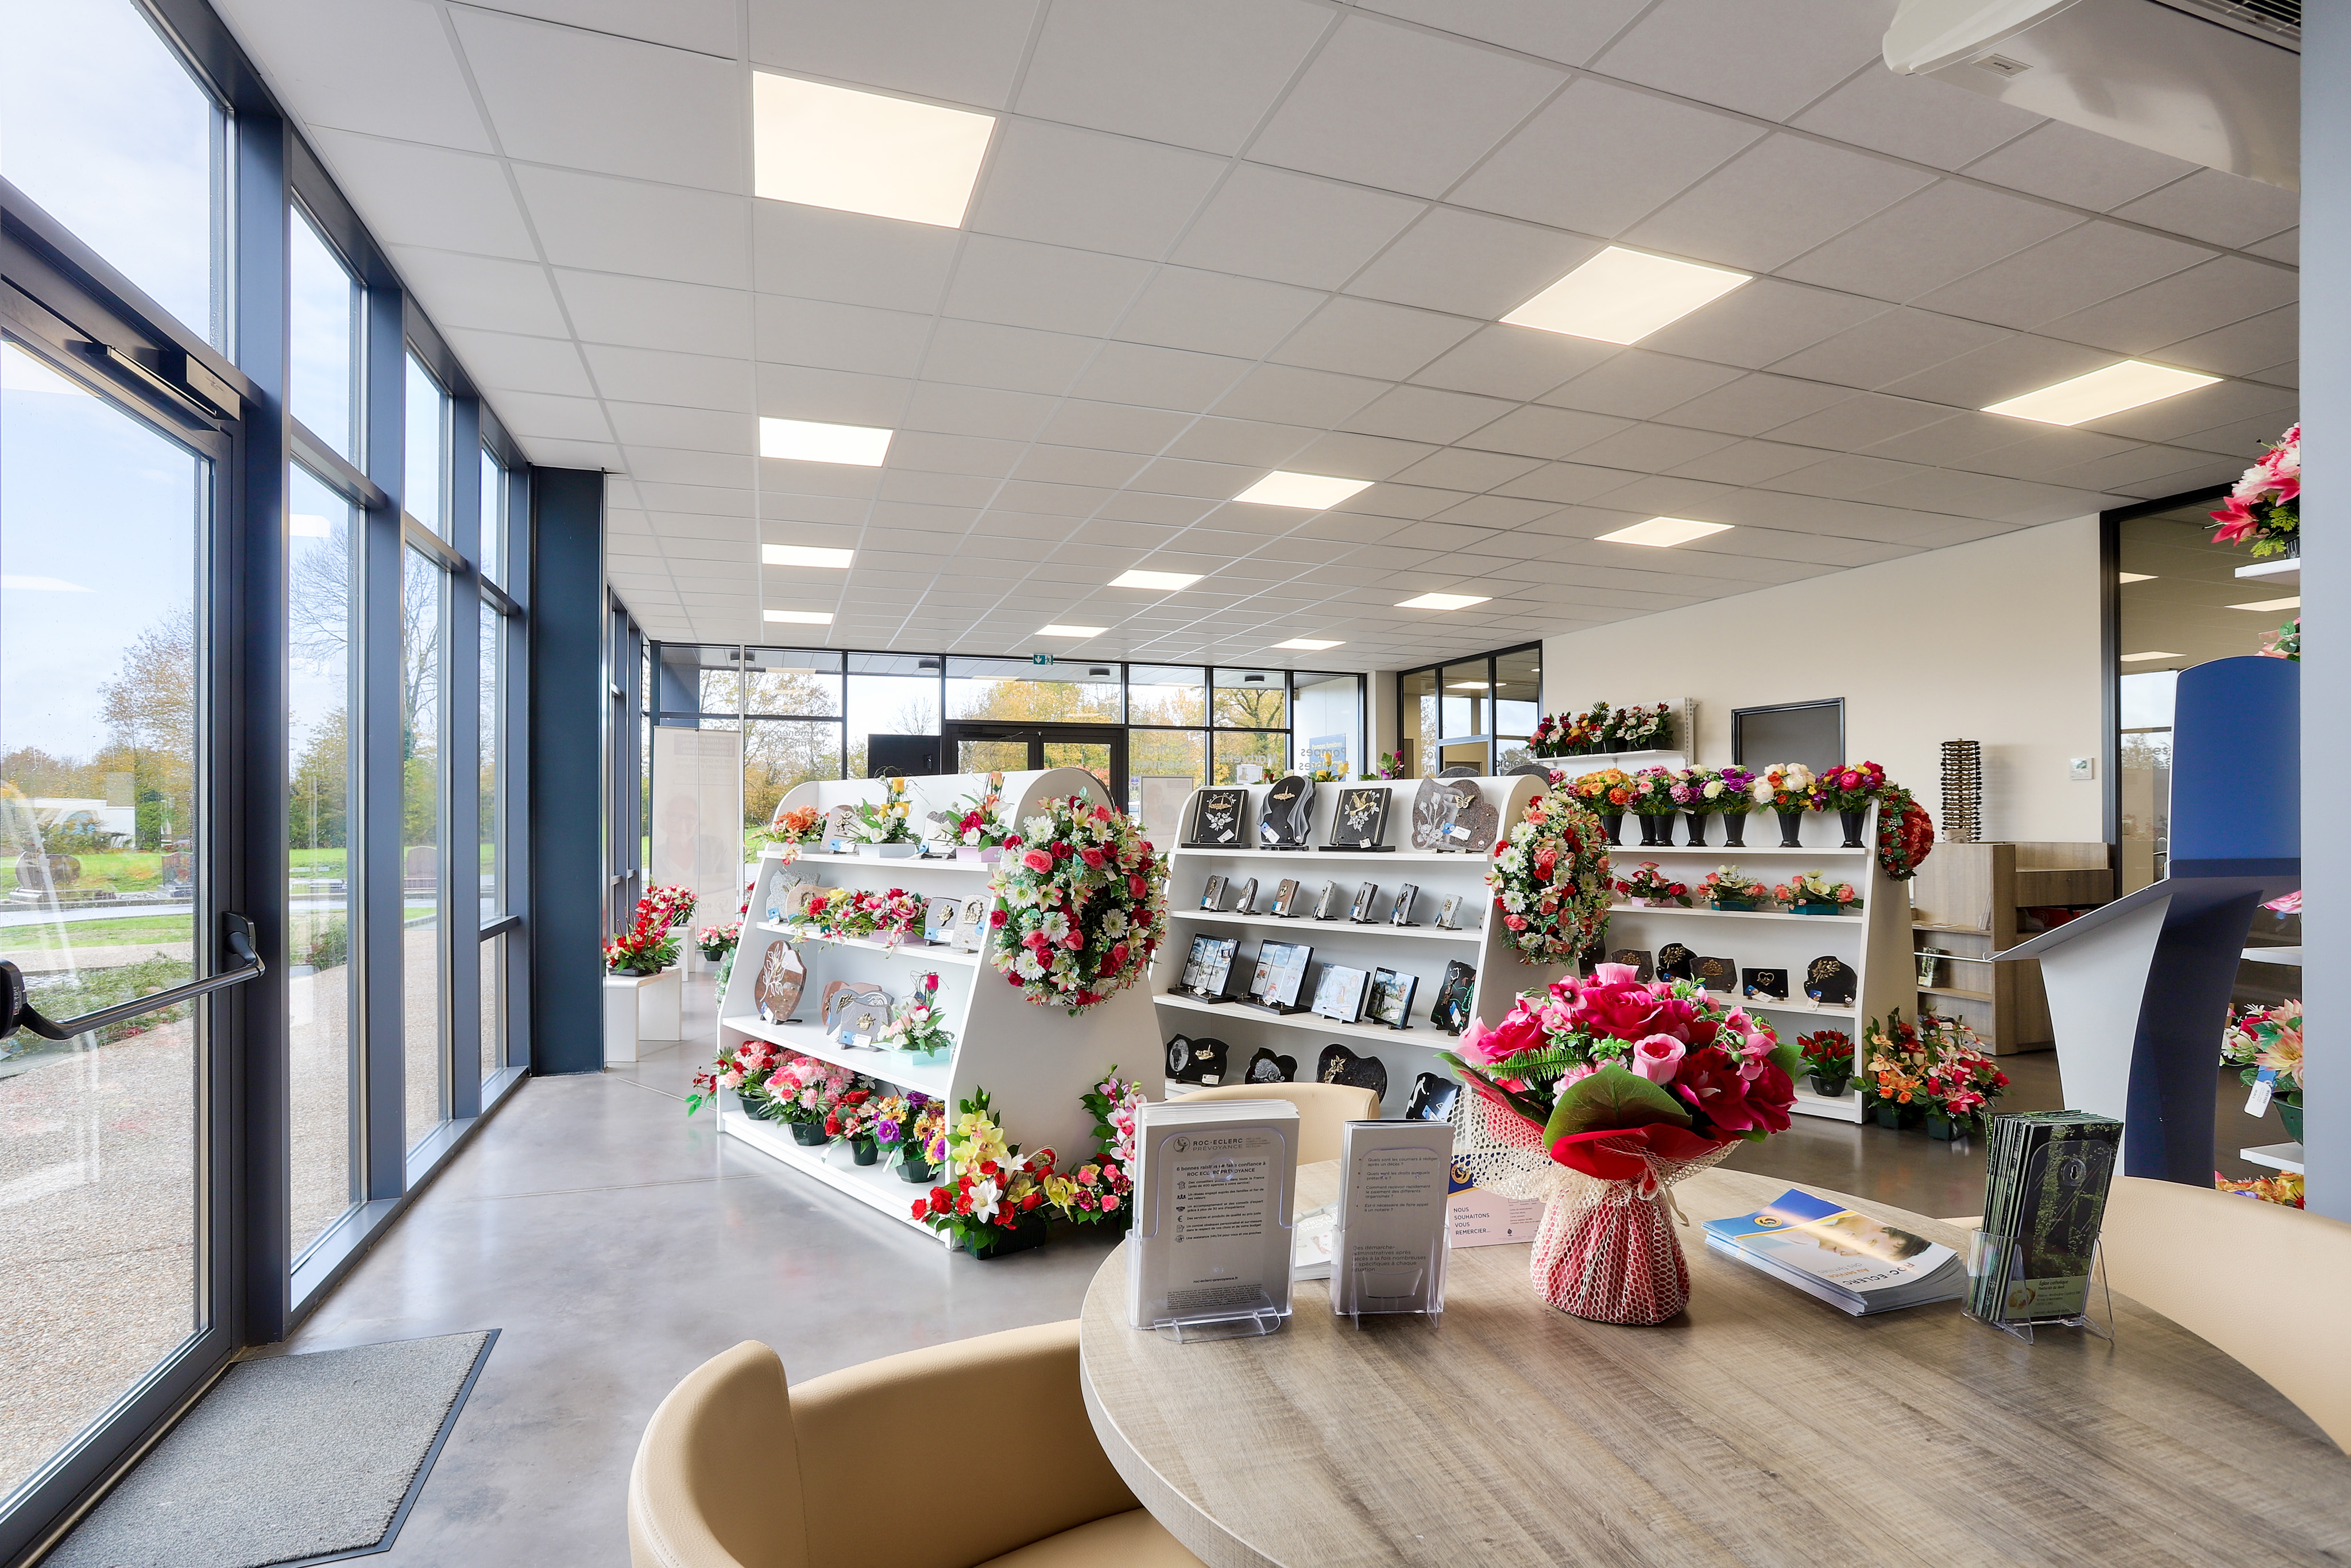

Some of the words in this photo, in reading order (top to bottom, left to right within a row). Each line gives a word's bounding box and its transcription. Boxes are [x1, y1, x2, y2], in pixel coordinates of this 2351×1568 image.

[1193, 1144, 1243, 1152] PRÉVOYANCE
[1454, 1213, 1490, 1221] SOUHAITONS
[1193, 1276, 1239, 1284] roc-eclerc-prevoyance.fr
